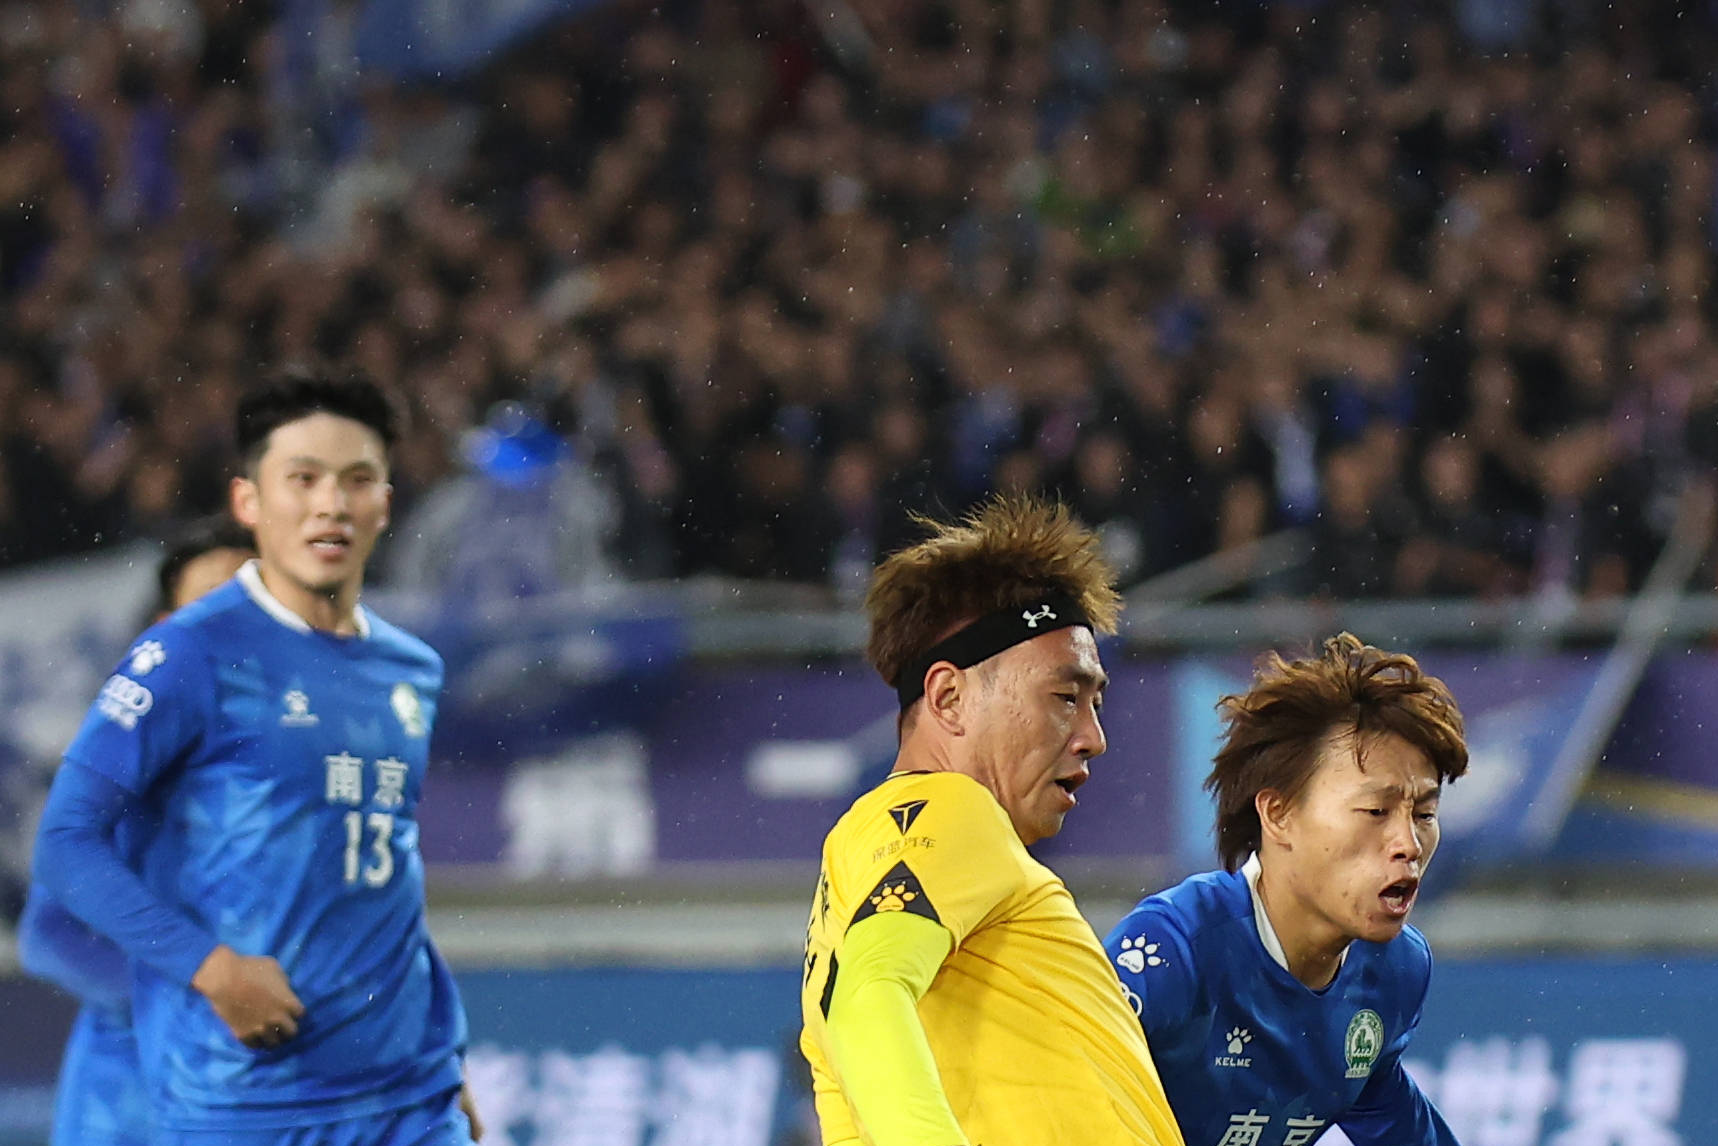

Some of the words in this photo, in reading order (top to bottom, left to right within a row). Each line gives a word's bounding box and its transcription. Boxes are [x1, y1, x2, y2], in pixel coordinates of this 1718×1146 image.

[325, 751, 409, 806] 南京
[344, 811, 395, 888] 13
[1215, 1056, 1252, 1068] KELME
